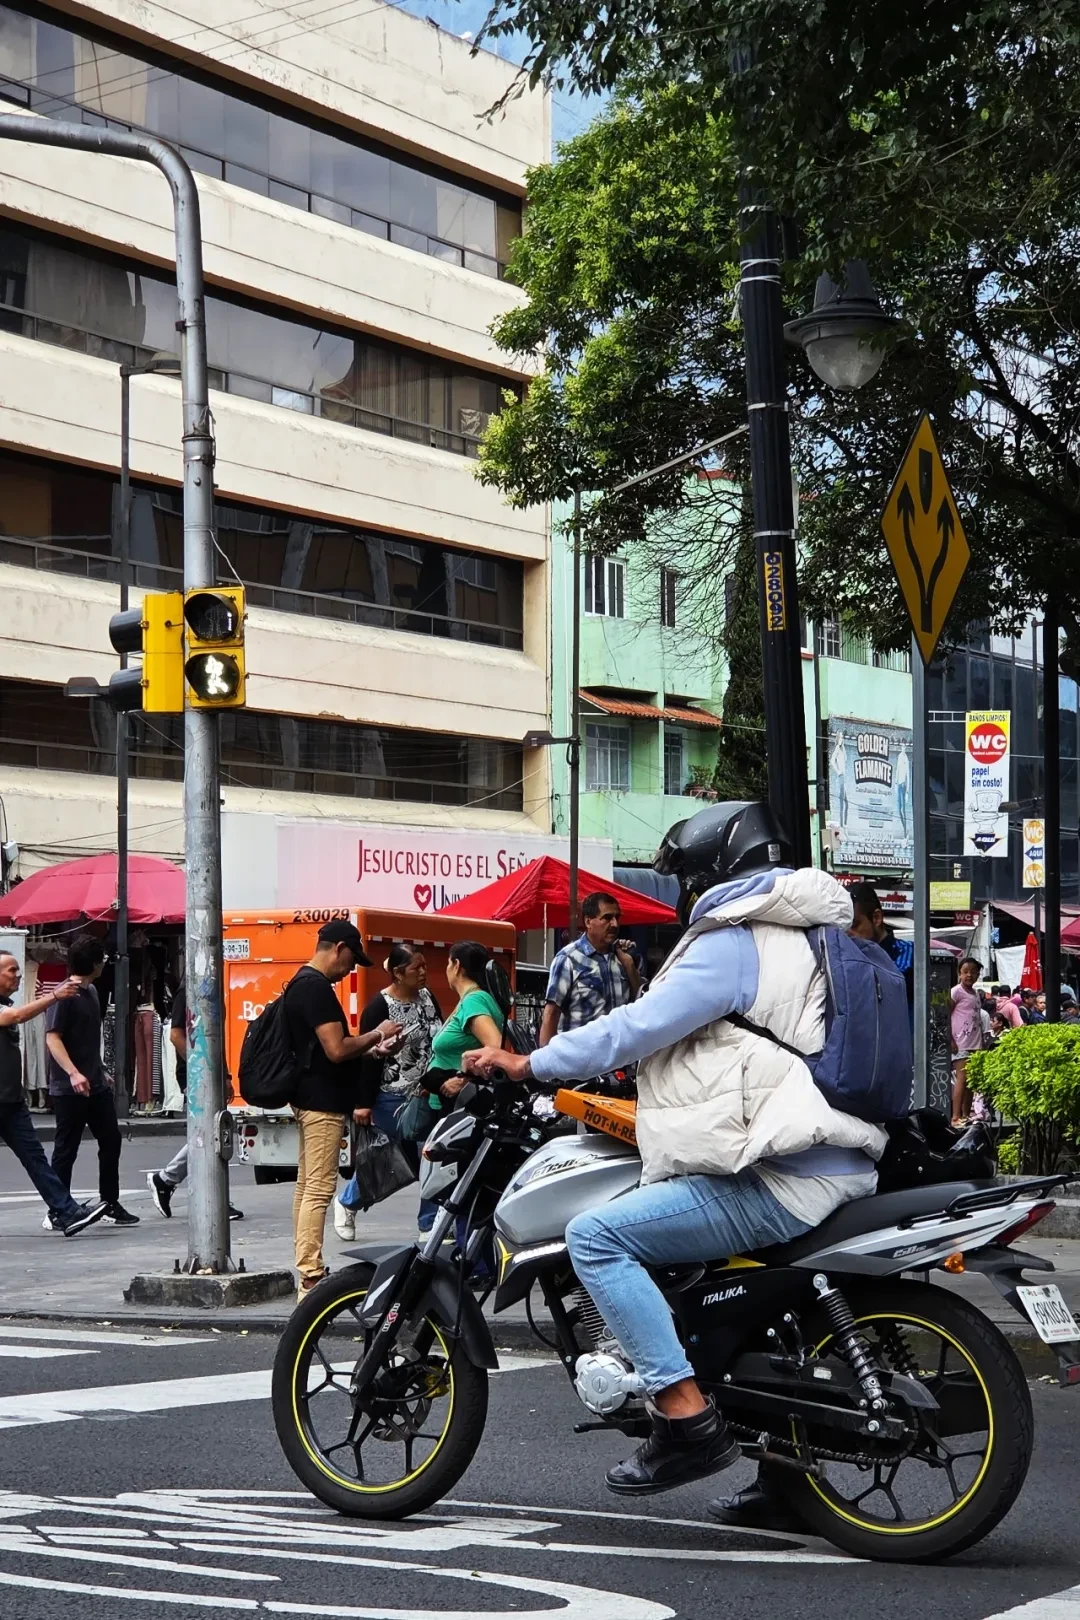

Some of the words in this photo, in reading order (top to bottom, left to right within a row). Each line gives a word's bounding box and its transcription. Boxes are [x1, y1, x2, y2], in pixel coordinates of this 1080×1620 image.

[857, 733, 889, 757] GOLDEN
[970, 734, 1007, 750] WC
[854, 759, 892, 784] FLAMANTE
[971, 765, 990, 778] papel
[971, 777, 981, 788] sin
[982, 777, 1003, 788] costo!
[1025, 827, 1044, 837] WC
[456, 854, 473, 879] ES
[476, 854, 492, 880] EL
[293, 908, 350, 923] 230029
[955, 913, 972, 921] WC
